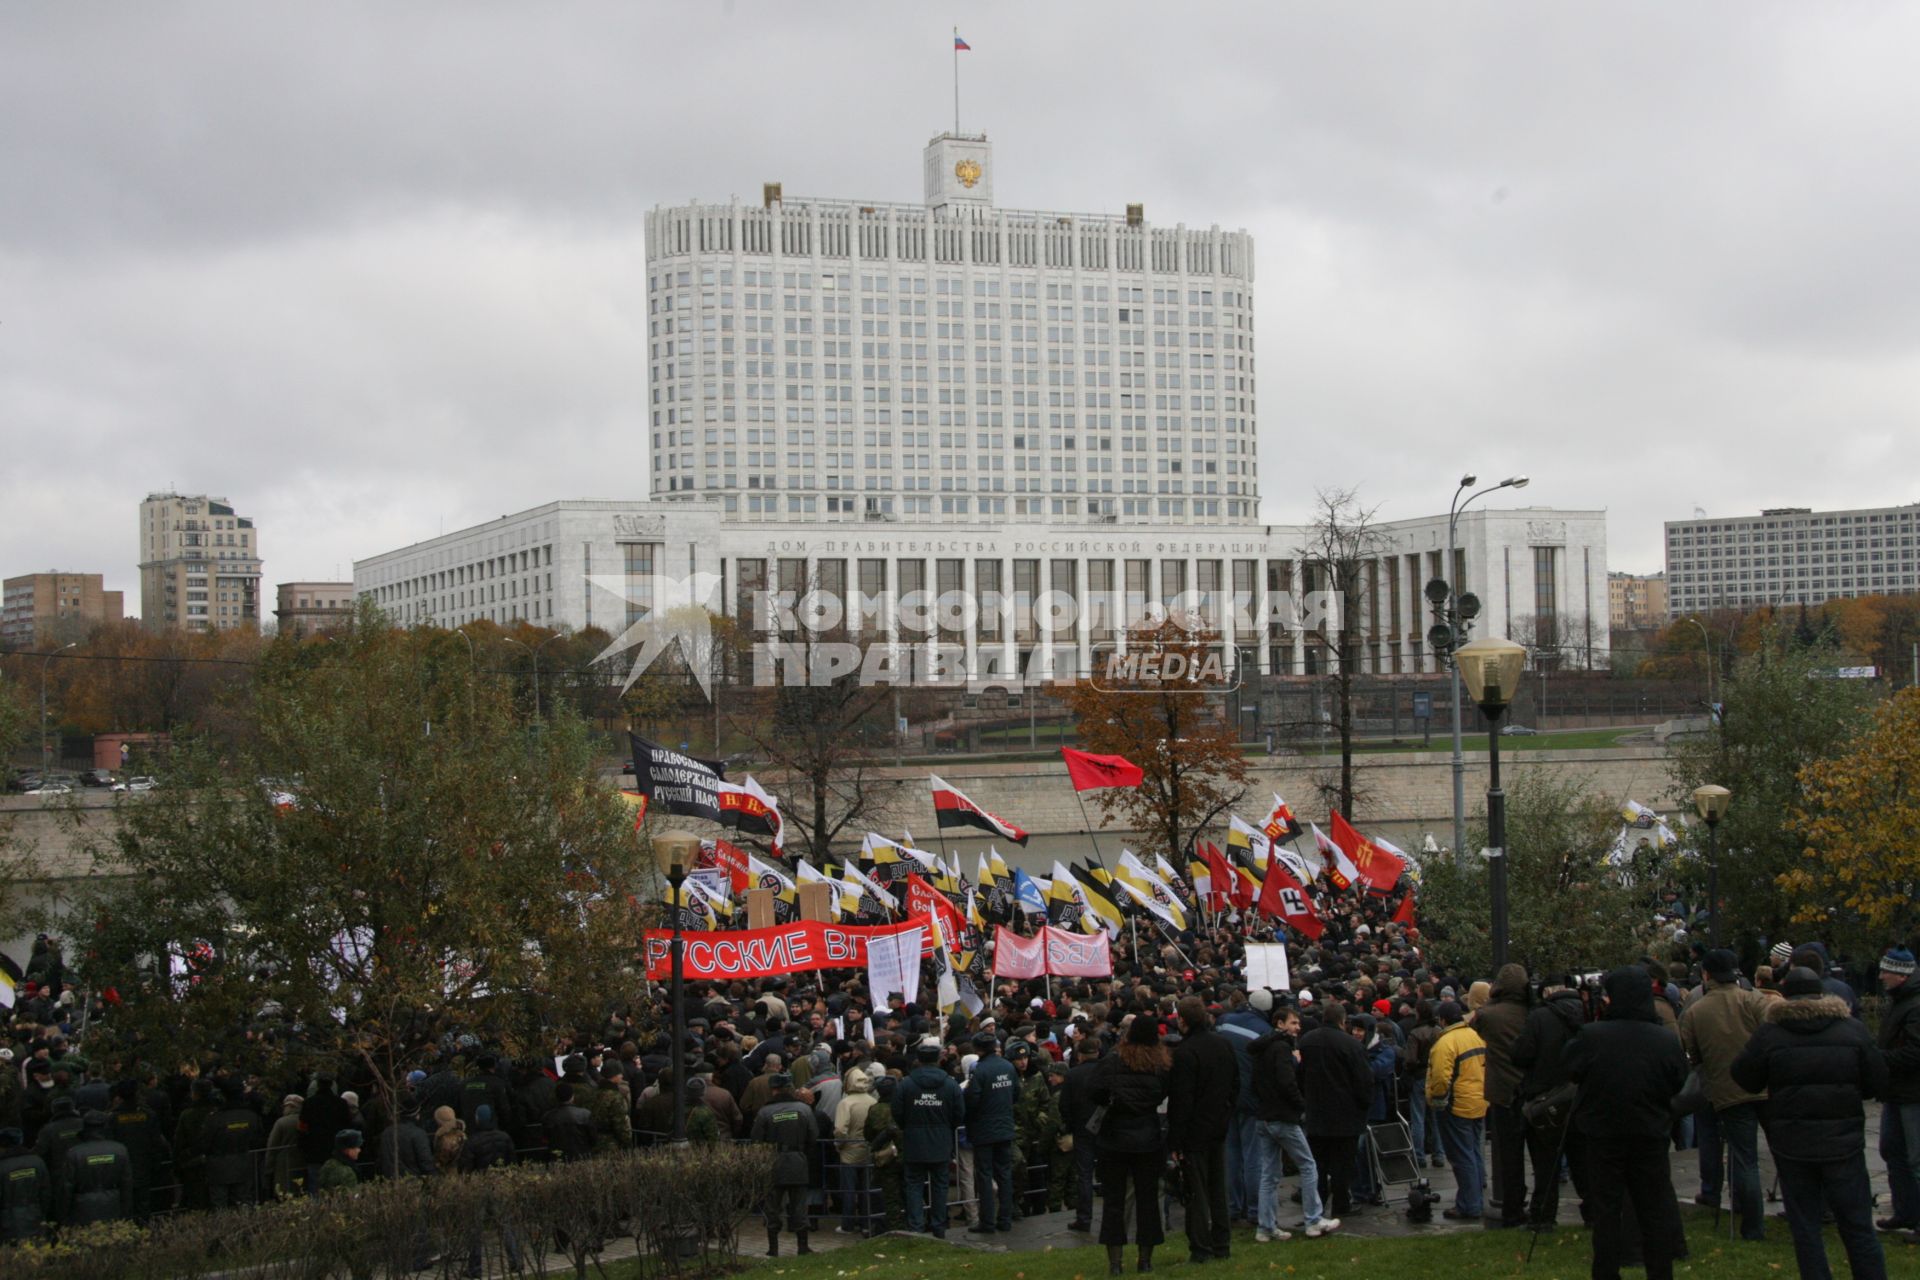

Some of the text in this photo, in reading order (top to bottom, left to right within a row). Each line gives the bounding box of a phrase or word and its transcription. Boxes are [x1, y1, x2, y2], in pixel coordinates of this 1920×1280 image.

[767, 539, 1269, 554] ДОМ ПРАВИТЕЛЬСТВА РОССИЙСКОЙ ФЕДЕРАЦИИ
[654, 785, 720, 813] РУССКИЙ НАРО
[914, 1099, 943, 1107] РОССИИ
